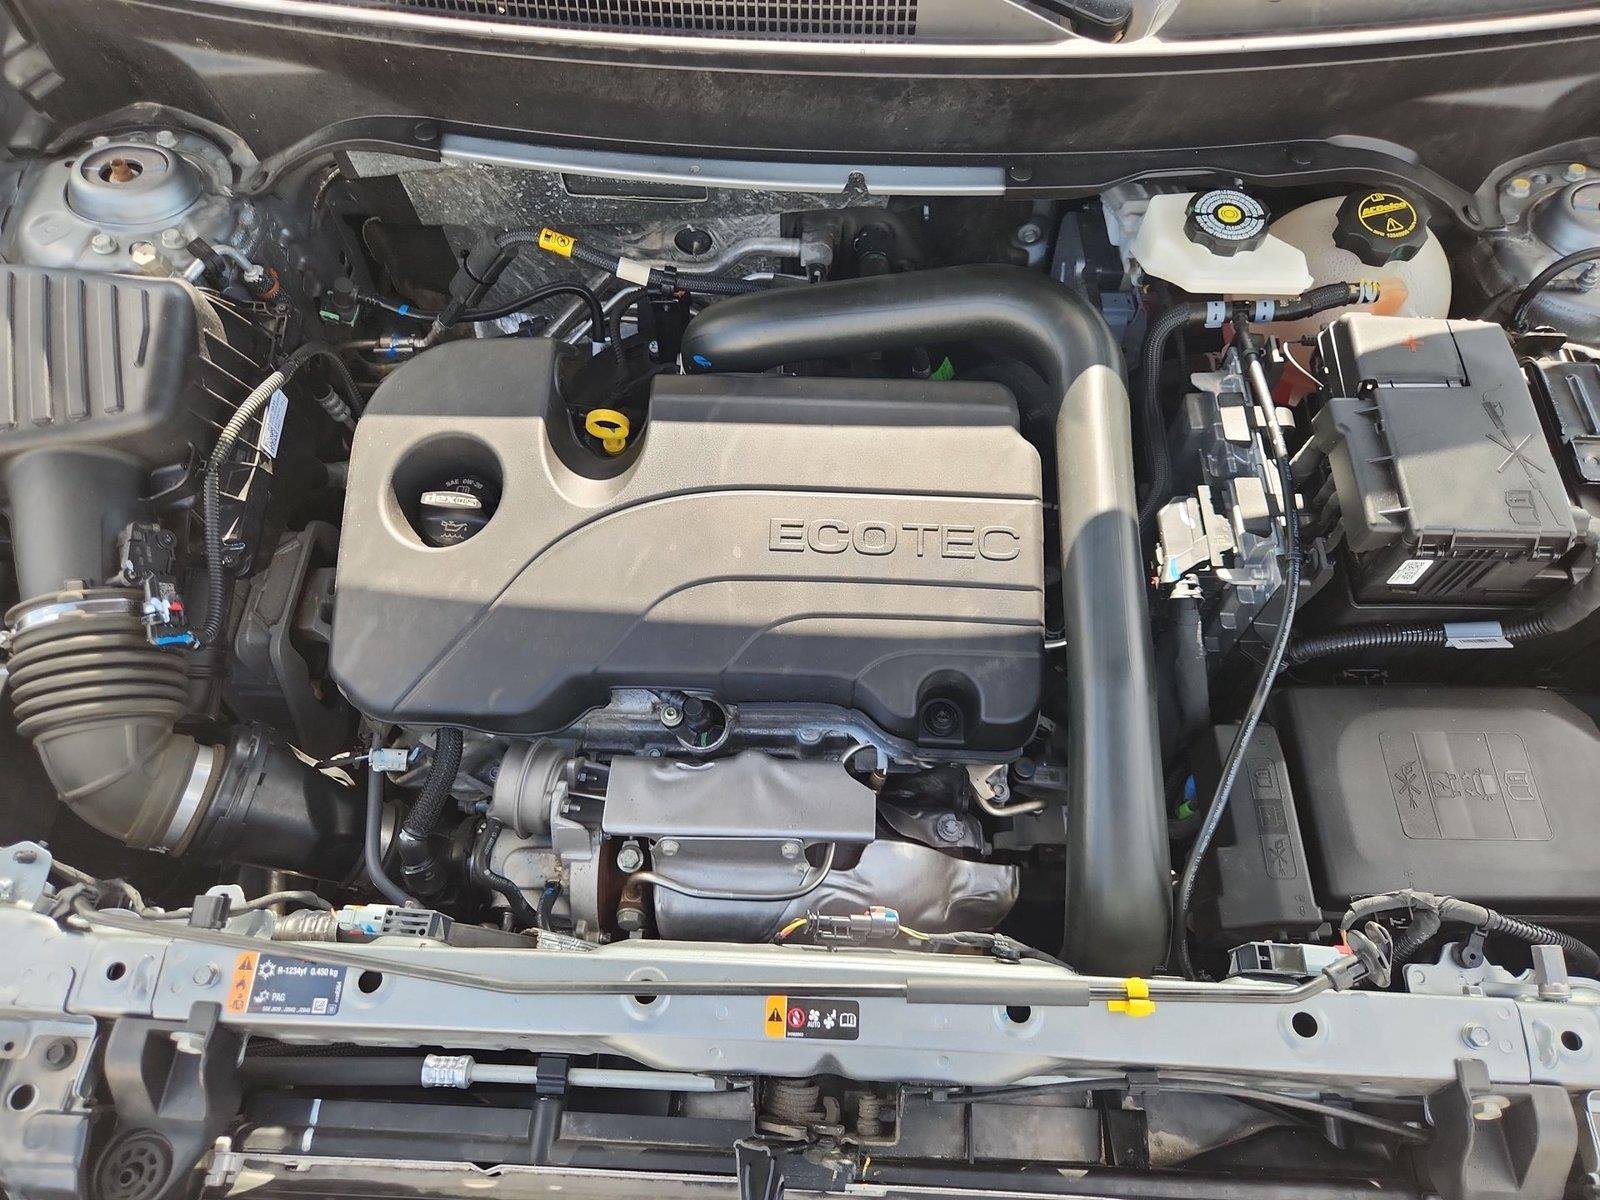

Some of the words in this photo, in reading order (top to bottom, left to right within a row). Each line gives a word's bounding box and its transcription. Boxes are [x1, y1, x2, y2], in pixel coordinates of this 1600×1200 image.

[1362, 202, 1407, 216] ACDelco
[446, 479, 459, 487] SAE
[424, 493, 477, 507] dexos
[768, 517, 1021, 562] ECOTEC
[329, 968, 339, 979] kg
[271, 992, 286, 1002] PAG
[807, 1020, 821, 1029] AUTO
